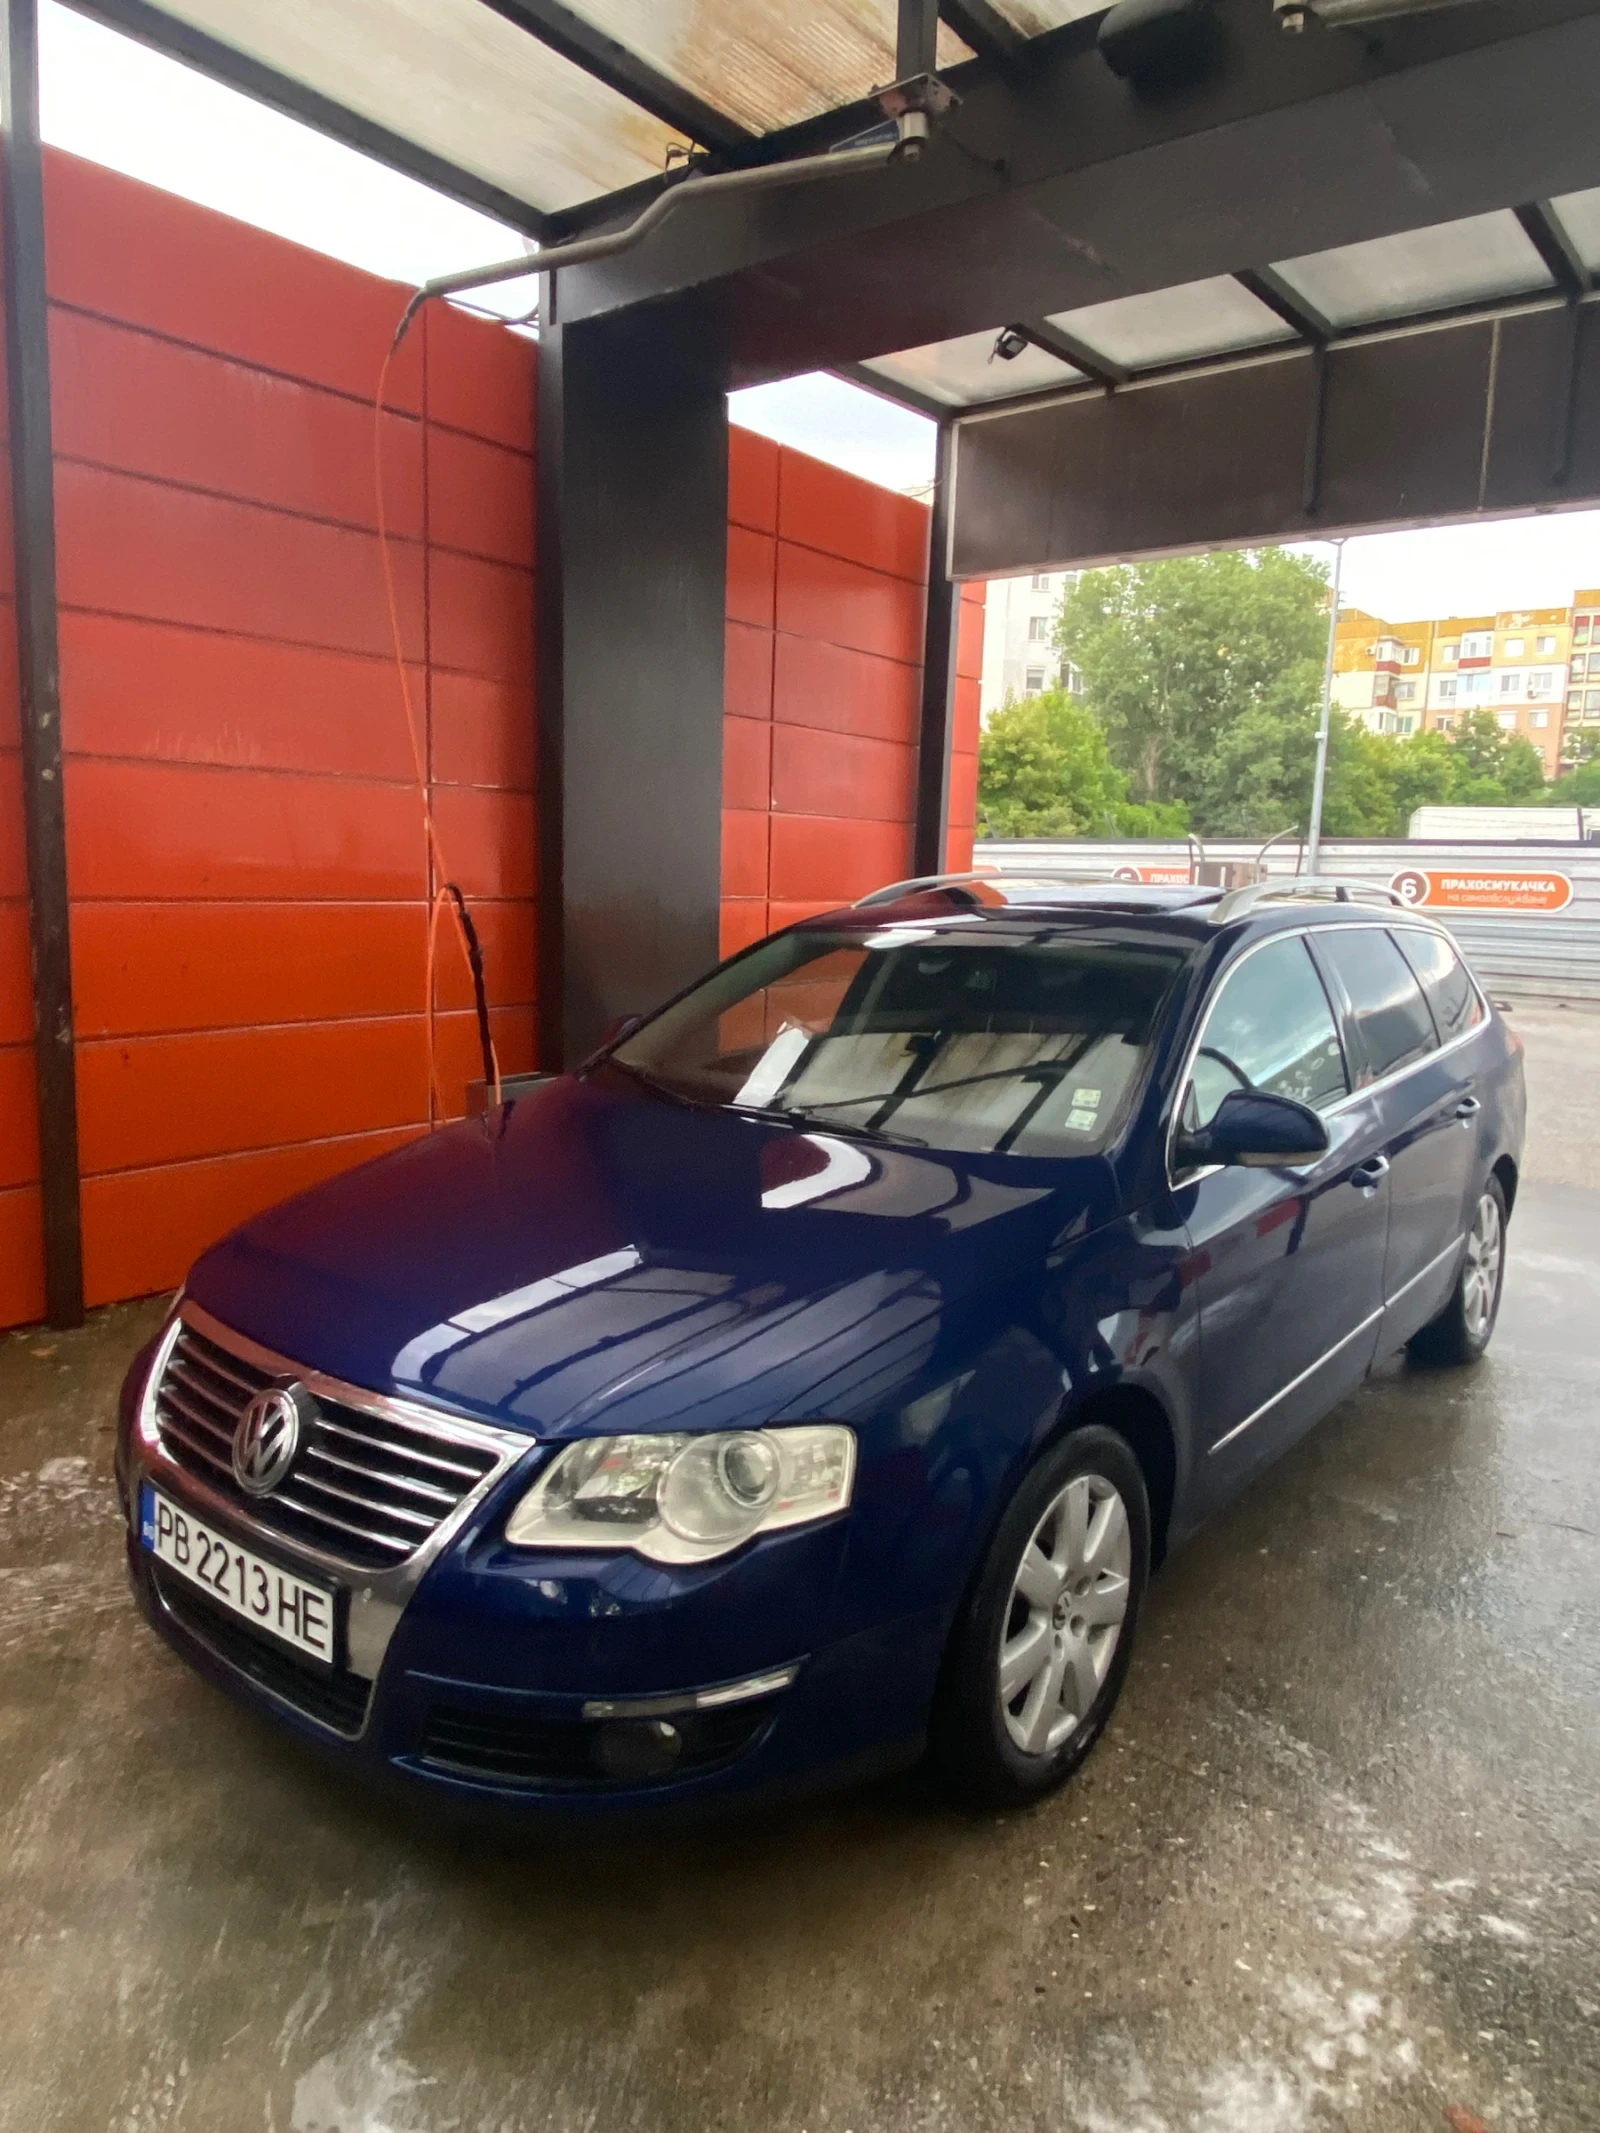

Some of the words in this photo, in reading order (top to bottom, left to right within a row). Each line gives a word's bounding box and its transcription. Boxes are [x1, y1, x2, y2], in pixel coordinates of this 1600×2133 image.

[1401, 878, 1417, 898] 6
[1441, 879, 1556, 892] ПРАХОСМУКАЧКА
[158, 1501, 190, 1565] PB
[196, 1531, 270, 1616] 2213
[278, 1576, 329, 1650] HE
